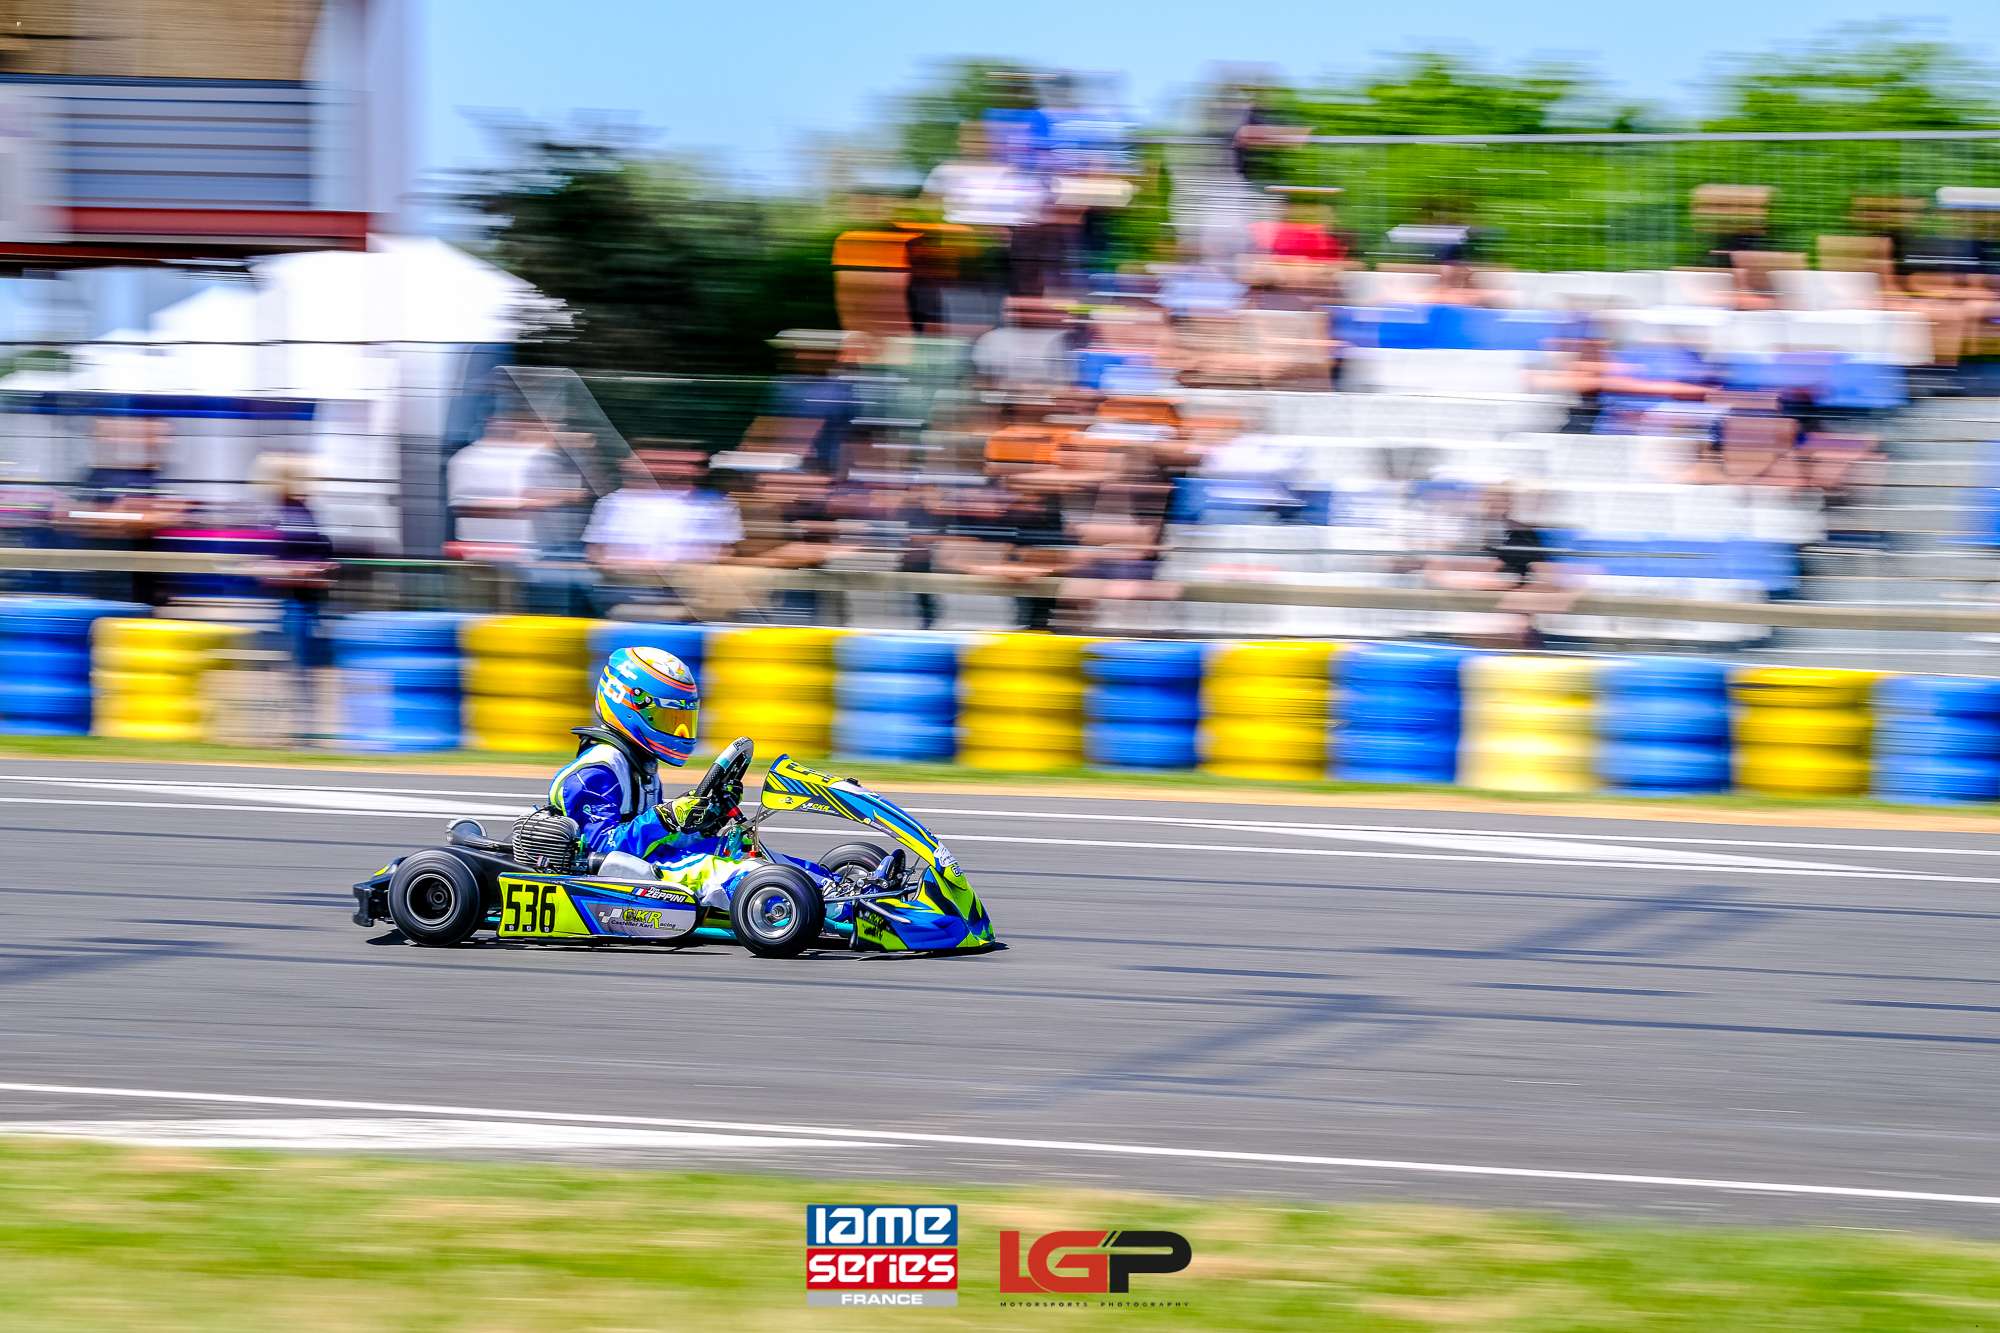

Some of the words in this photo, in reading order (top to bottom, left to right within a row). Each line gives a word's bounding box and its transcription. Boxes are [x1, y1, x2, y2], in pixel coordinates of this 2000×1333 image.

[647, 890, 685, 903] ZEPPINI
[504, 884, 556, 933] 536
[623, 909, 662, 928] CKR
